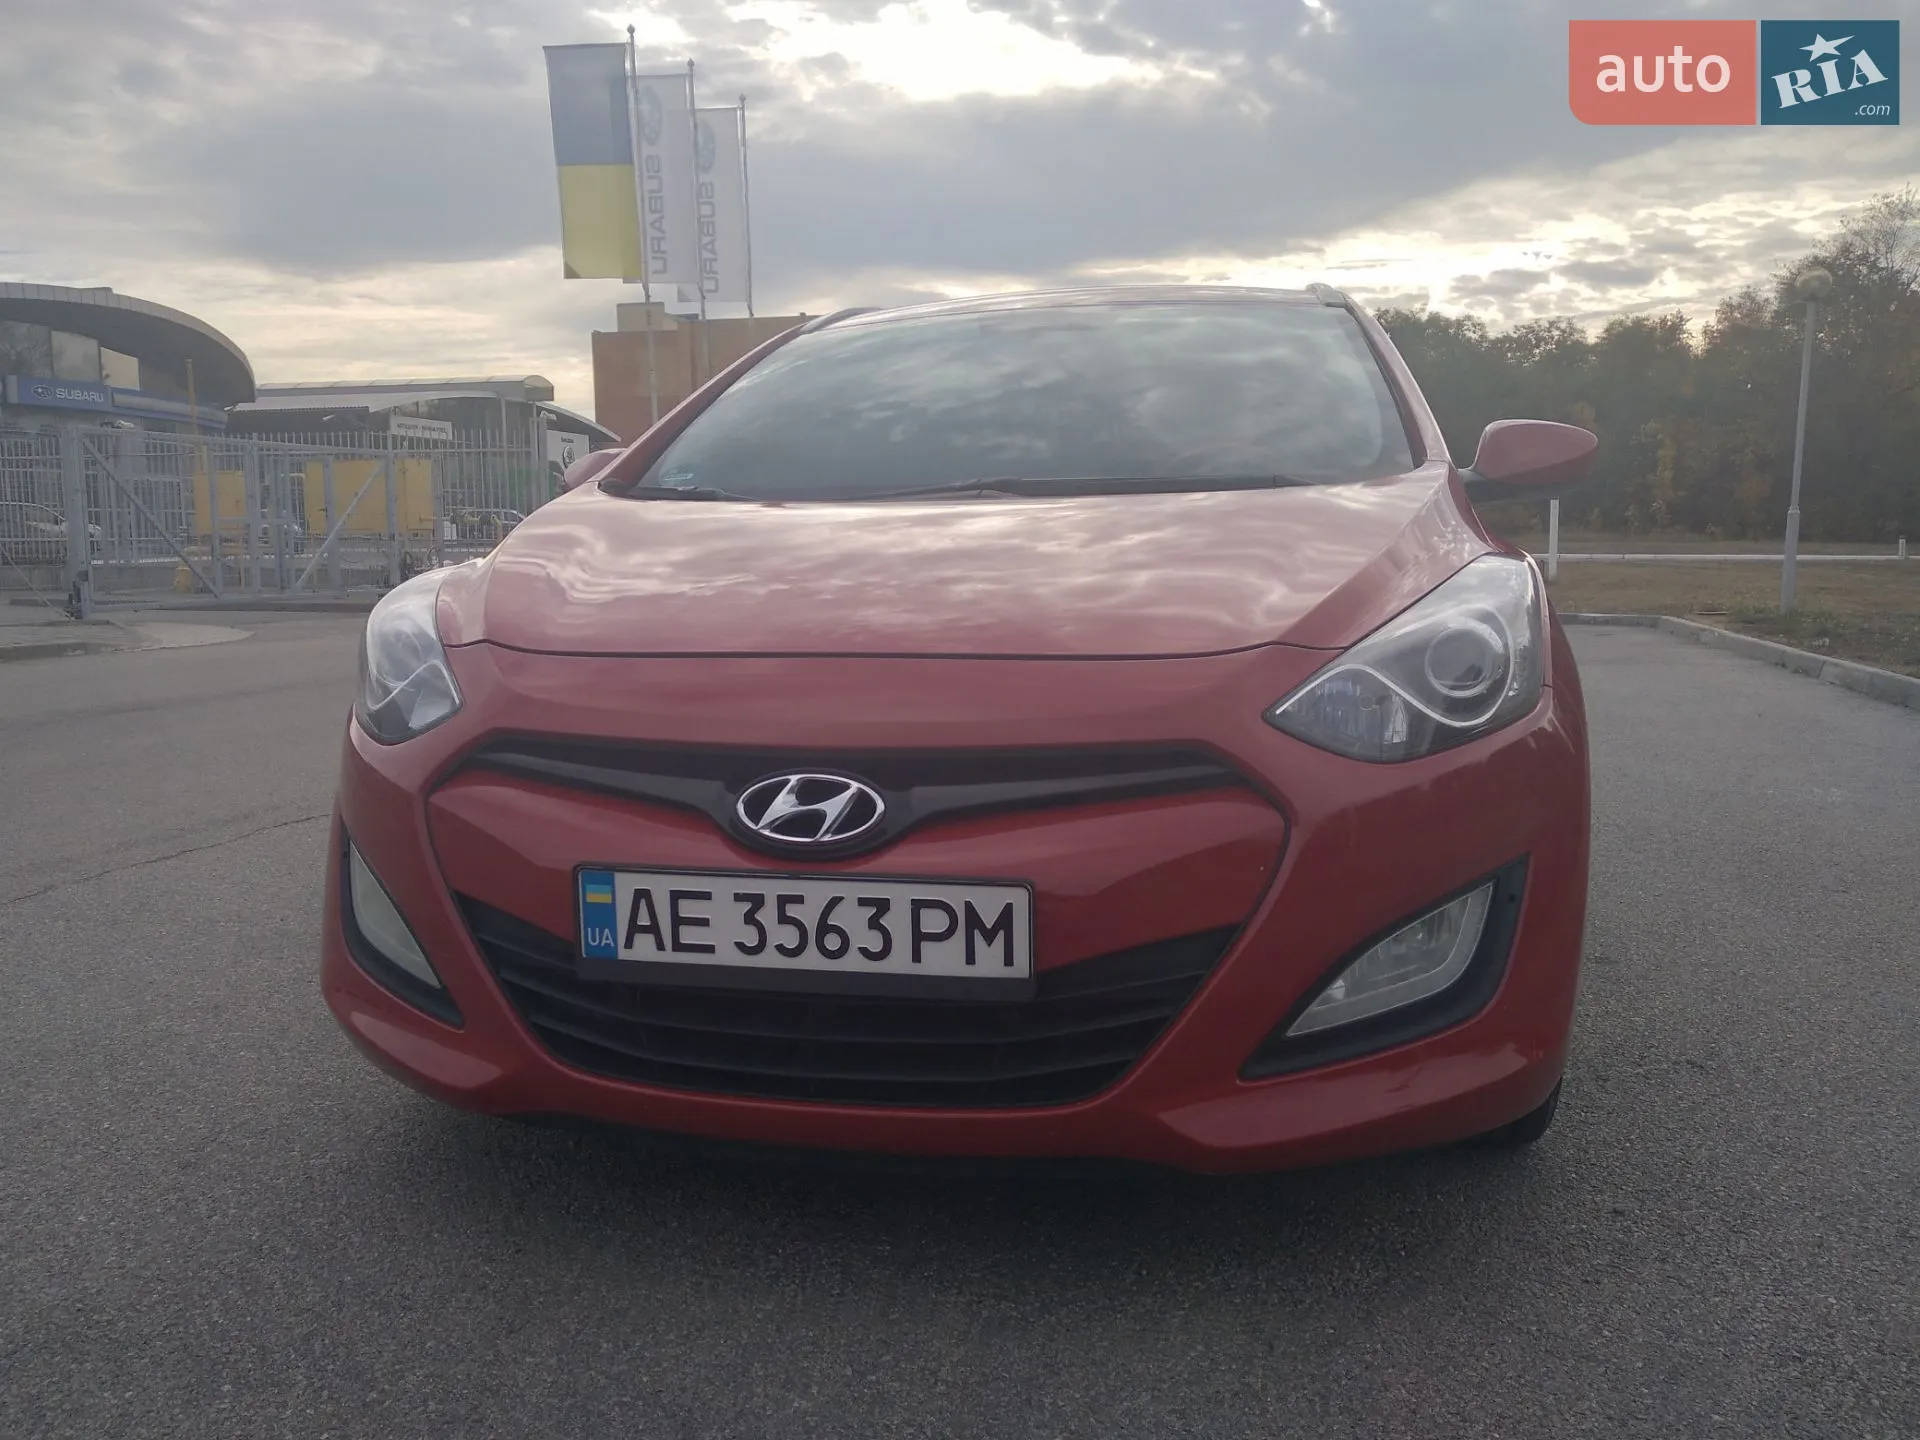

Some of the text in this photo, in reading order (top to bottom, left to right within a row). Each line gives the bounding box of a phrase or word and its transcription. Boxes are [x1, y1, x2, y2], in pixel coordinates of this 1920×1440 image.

[55, 387, 104, 402] SUBARU
[587, 927, 615, 947] UA
[622, 886, 1014, 968] AE 3563 PM
